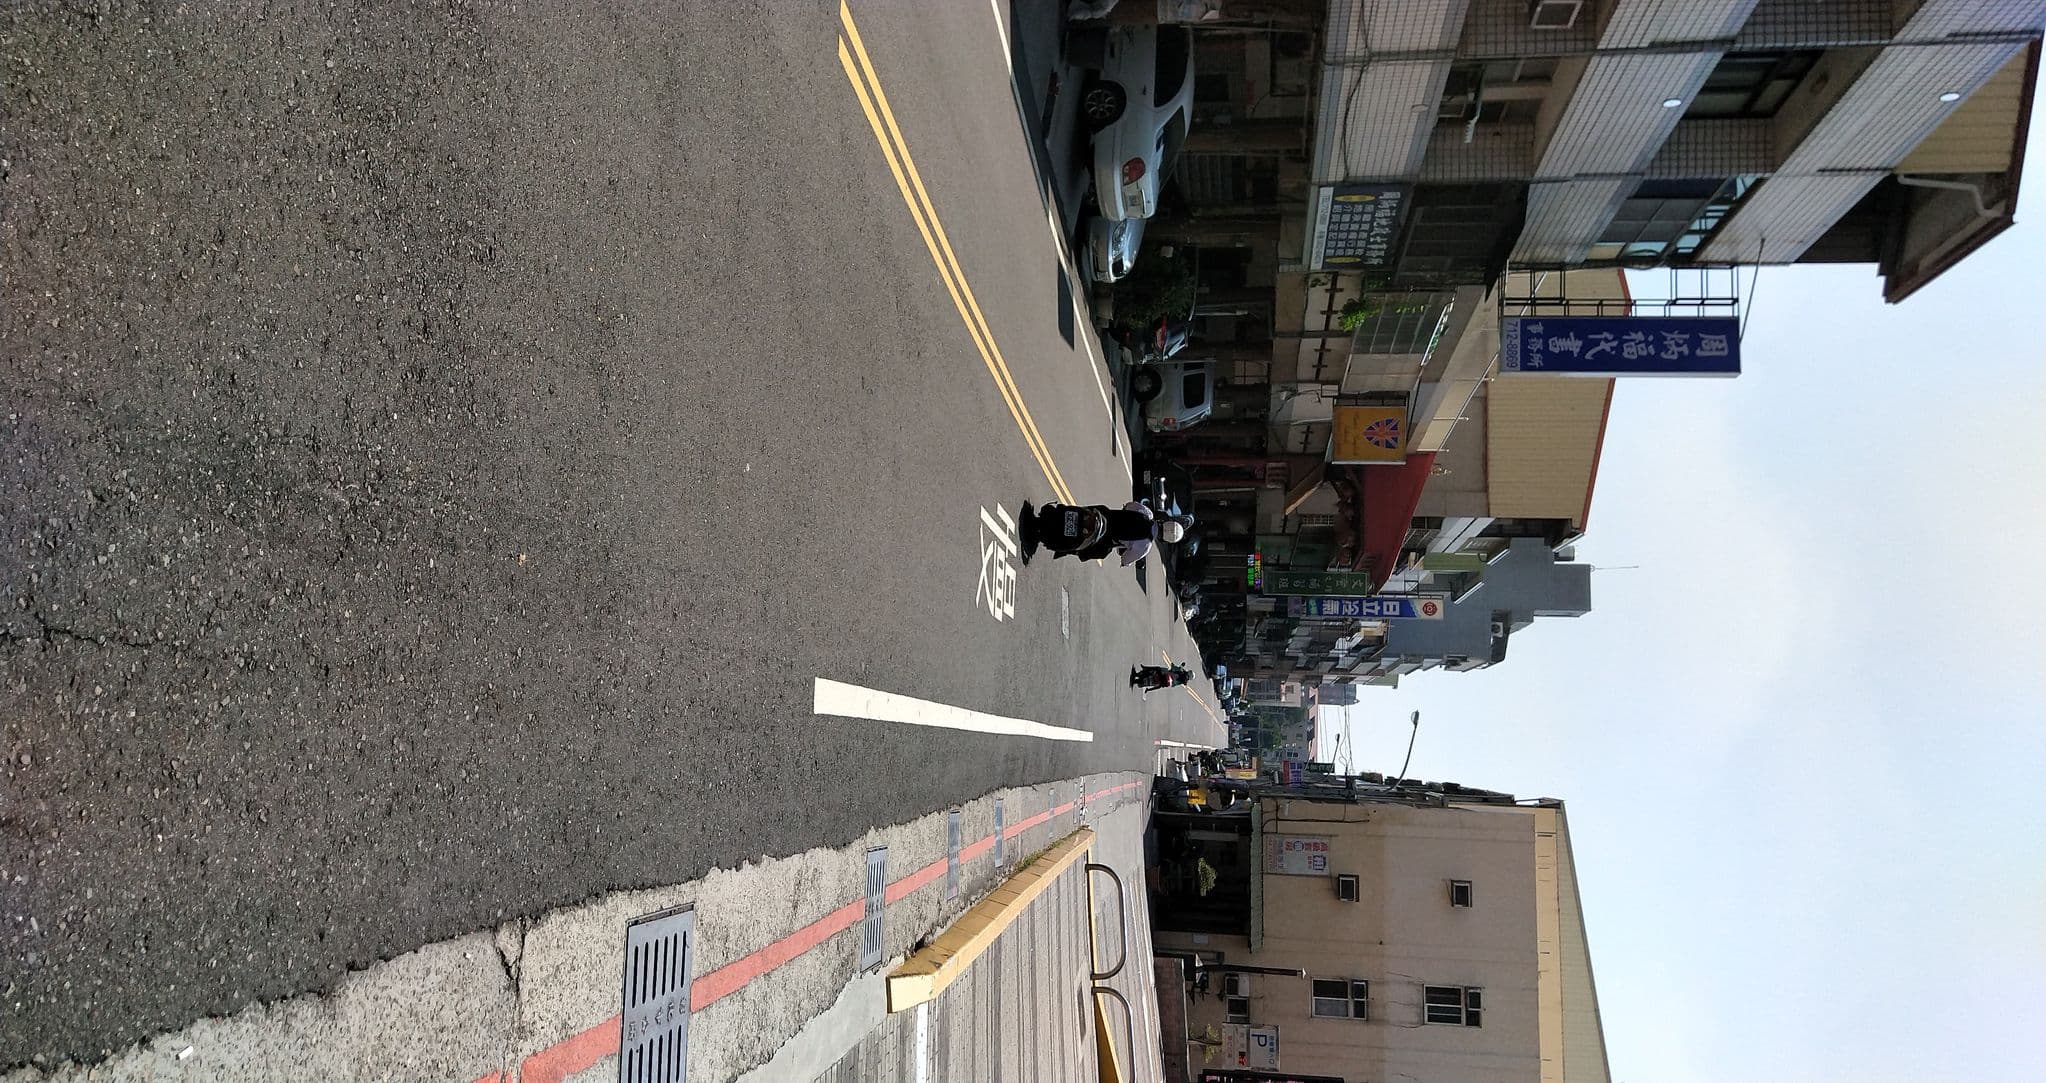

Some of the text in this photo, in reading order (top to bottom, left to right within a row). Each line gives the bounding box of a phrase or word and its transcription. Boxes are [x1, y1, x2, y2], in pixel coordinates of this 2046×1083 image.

[1505, 321, 1519, 368] 712-8869
[1527, 322, 1544, 368] 事務所
[1548, 330, 1730, 360] 周炳福代書
[975, 502, 1017, 623] 慢
[1322, 600, 1400, 616] 日立冷氣
[1251, 1034, 1267, 1047] P
